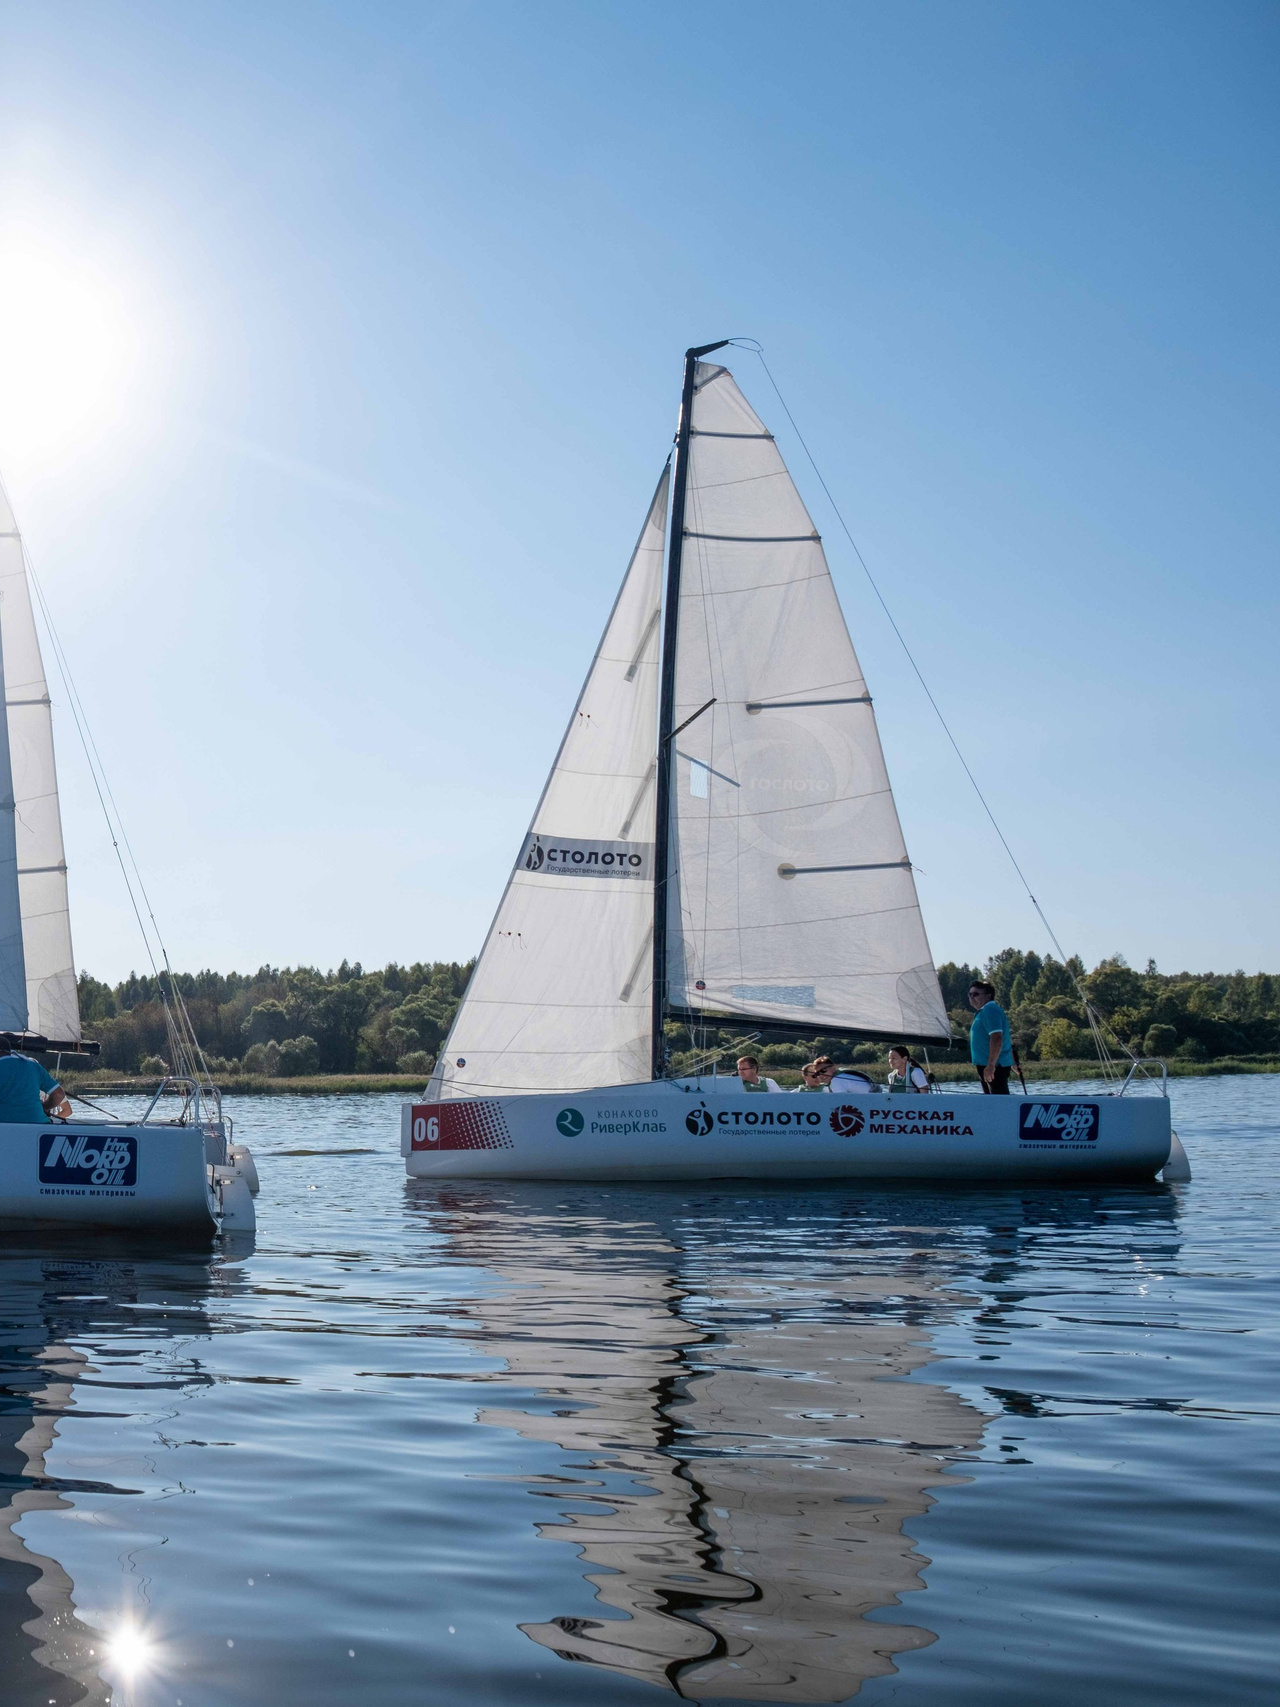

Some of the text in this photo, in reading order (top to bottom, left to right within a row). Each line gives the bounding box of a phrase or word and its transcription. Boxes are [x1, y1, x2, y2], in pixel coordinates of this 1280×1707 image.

[547, 848, 642, 867] СТОЛОТО
[547, 864, 610, 874] Государственные
[597, 1109, 658, 1119] КОНАКОВО
[717, 1112, 821, 1125] СТОЛОТО
[870, 1110, 954, 1120] РУССКАЯ
[1023, 1105, 1094, 1128] NORD
[414, 1117, 439, 1142] 06
[591, 1121, 666, 1135] РиверКлаб
[870, 1124, 974, 1135] МЕХАНИКА
[1061, 1128, 1089, 1140] OIL
[44, 1136, 131, 1169] NORD
[91, 1168, 125, 1185] OIL
